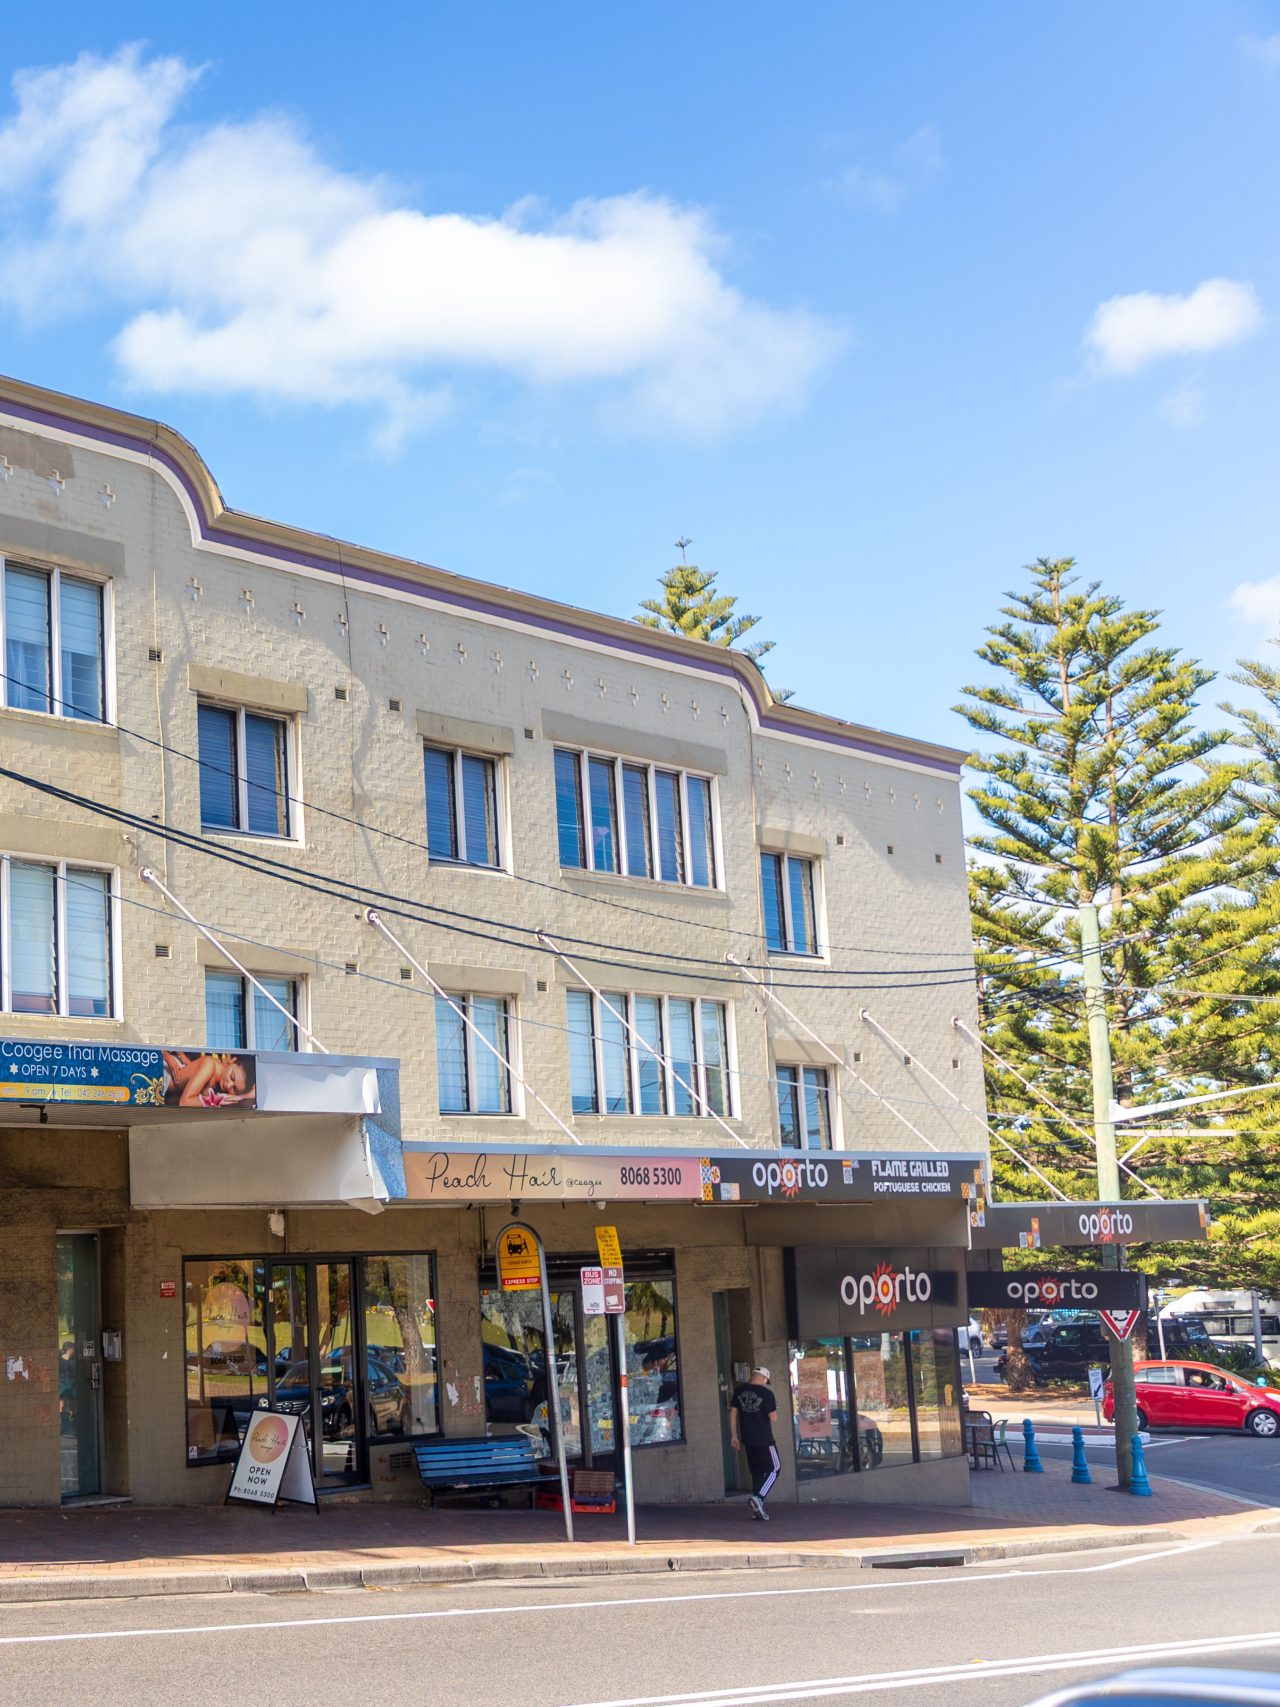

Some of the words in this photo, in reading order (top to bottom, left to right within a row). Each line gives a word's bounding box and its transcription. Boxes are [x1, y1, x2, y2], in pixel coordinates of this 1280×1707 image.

[1, 1042, 63, 1065] Coogee
[67, 1043, 95, 1061] Thai
[98, 1048, 159, 1067] Massage
[21, 1064, 50, 1077] OPEN
[52, 1065, 58, 1077] 7
[61, 1066, 87, 1078] DAYS
[425, 1152, 492, 1193] Peach
[503, 1153, 562, 1191] Hair
[620, 1166, 651, 1186] 8068
[653, 1166, 682, 1186] 5300
[752, 1159, 828, 1195] oporto
[871, 1160, 908, 1178] FLAME
[909, 1160, 949, 1178] GRILLED
[921, 1182, 951, 1193] CHICKEN
[1079, 1209, 1133, 1241] oporto
[608, 1269, 617, 1277] NO
[841, 1266, 931, 1314] oporto
[1007, 1279, 1098, 1304] oporto
[247, 1475, 268, 1485] NOW
[249, 1466, 272, 1476] OPEN
[259, 1490, 275, 1499] 5300
